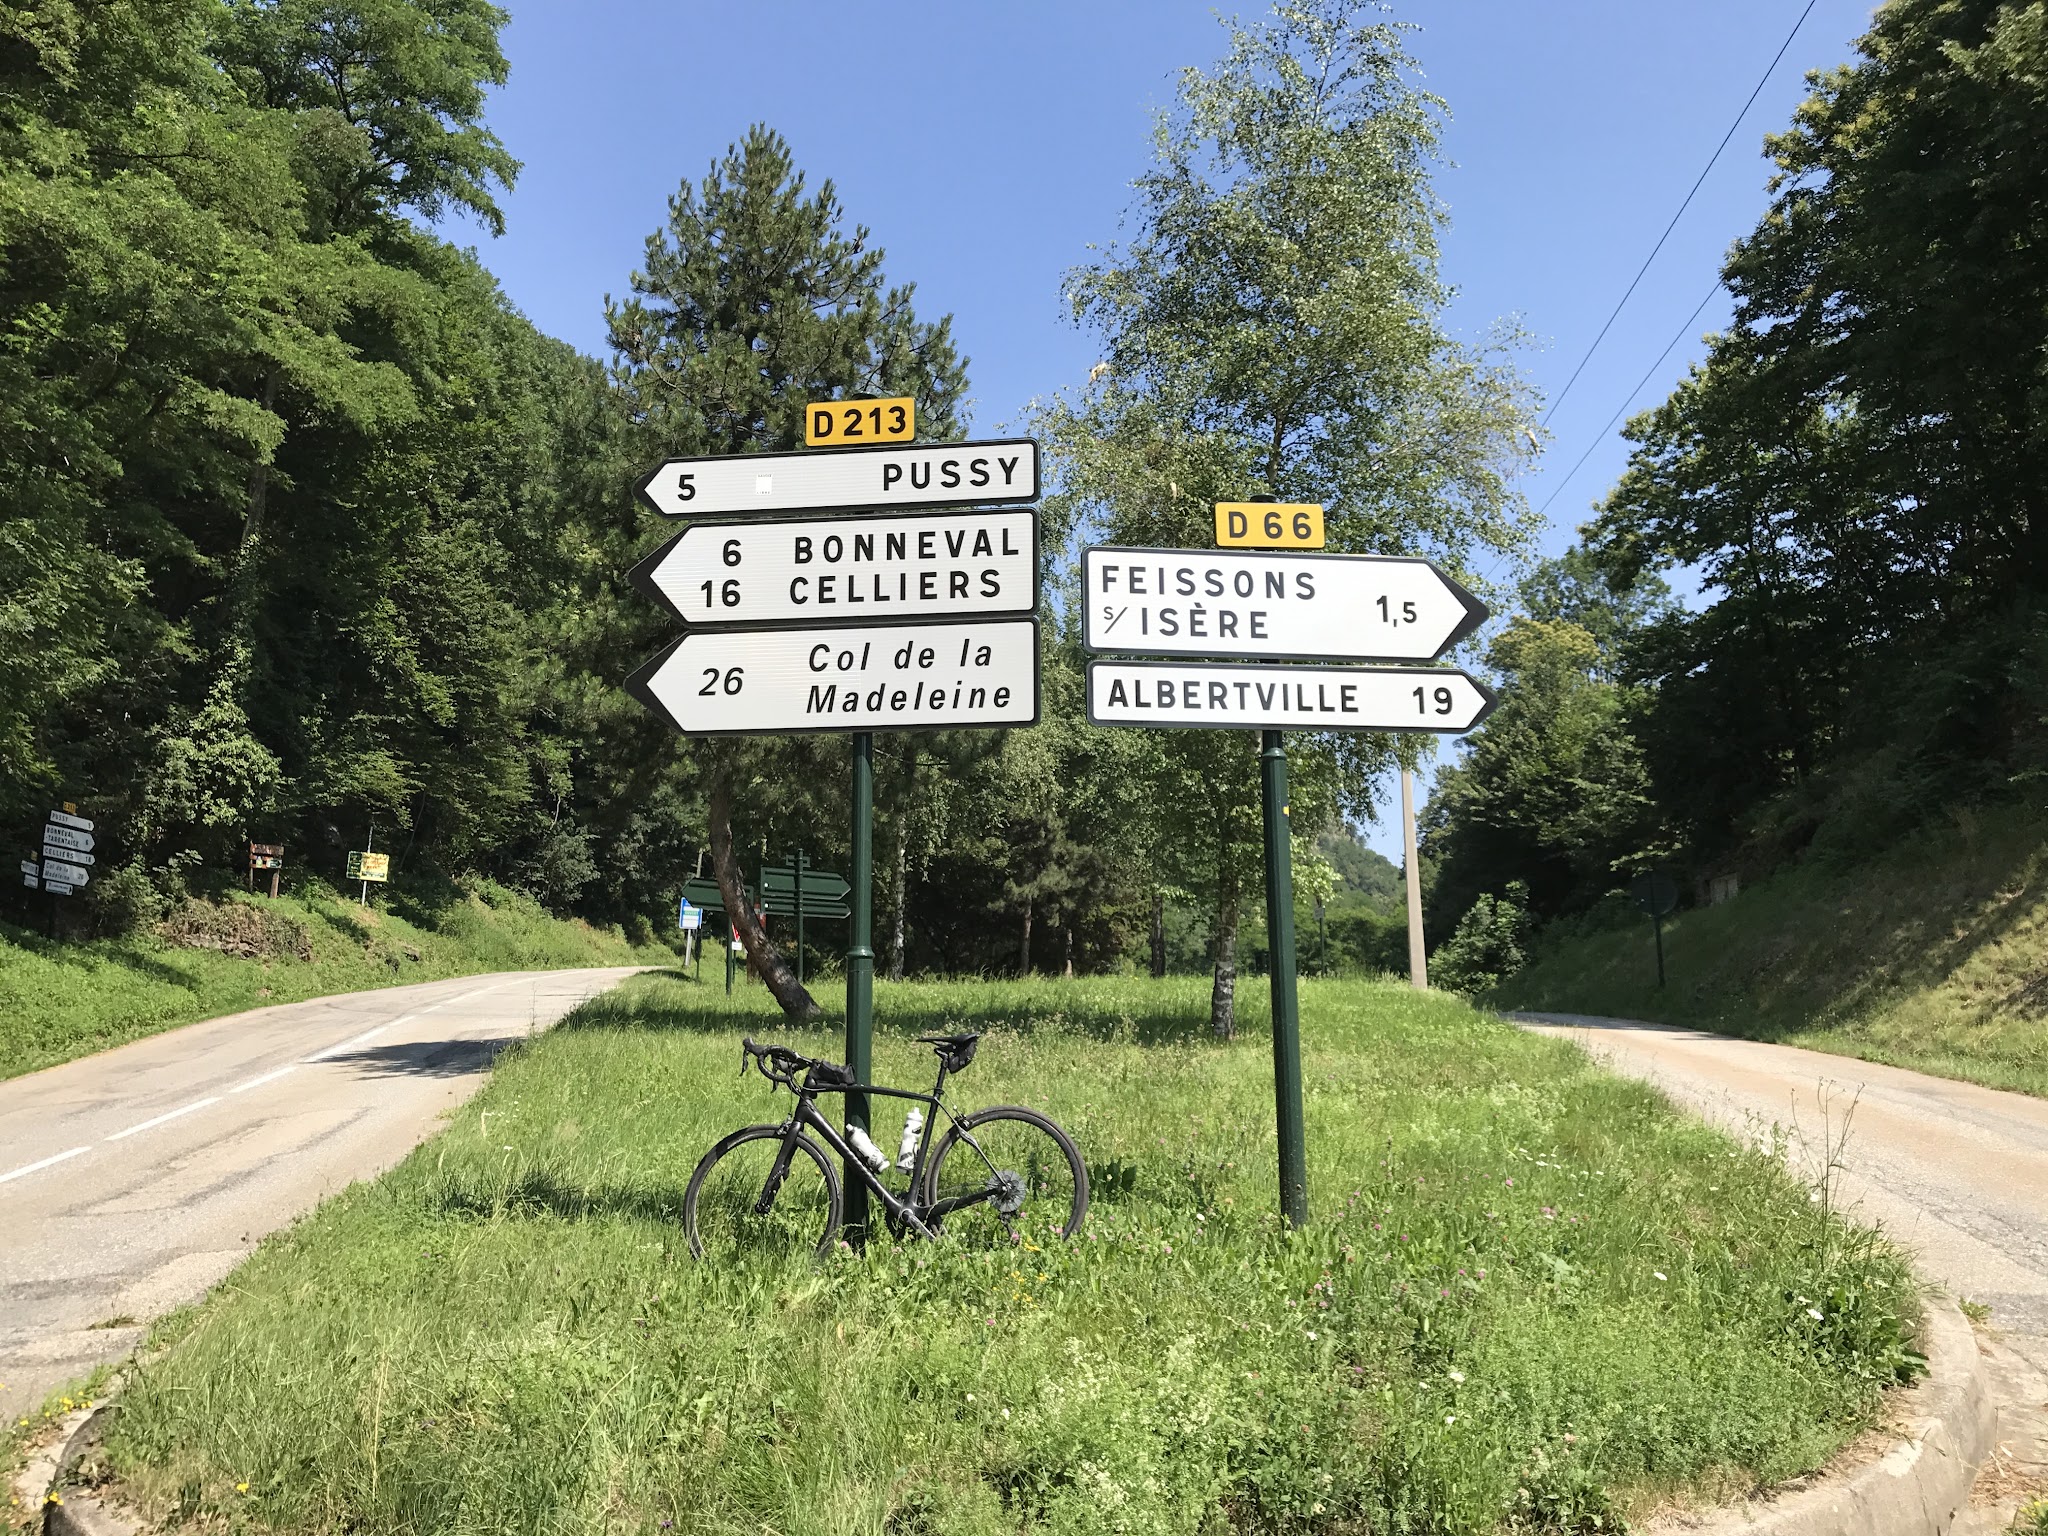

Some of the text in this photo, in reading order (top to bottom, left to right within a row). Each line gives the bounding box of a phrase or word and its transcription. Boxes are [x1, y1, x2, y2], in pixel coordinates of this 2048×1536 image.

[814, 406, 905, 438] D 213
[678, 457, 1019, 501] 5 PUSSY
[1229, 511, 1311, 539] D 66
[723, 528, 1018, 566] 6 BONNEVAL
[701, 569, 1000, 607] 16 CELLIERS
[1103, 565, 1315, 600] FEISSONS
[1142, 602, 1268, 639] ISÈRE
[1377, 596, 1417, 627] 1,5
[809, 639, 991, 672] Col de la
[699, 667, 744, 696] 26
[807, 681, 1010, 713] Madeleine
[1108, 679, 1452, 715] ALBERTVILLE 19
[46, 826, 74, 839] BONNEVAL
[52, 813, 68, 822] PUSSY
[45, 848, 74, 859] CELLIERS
